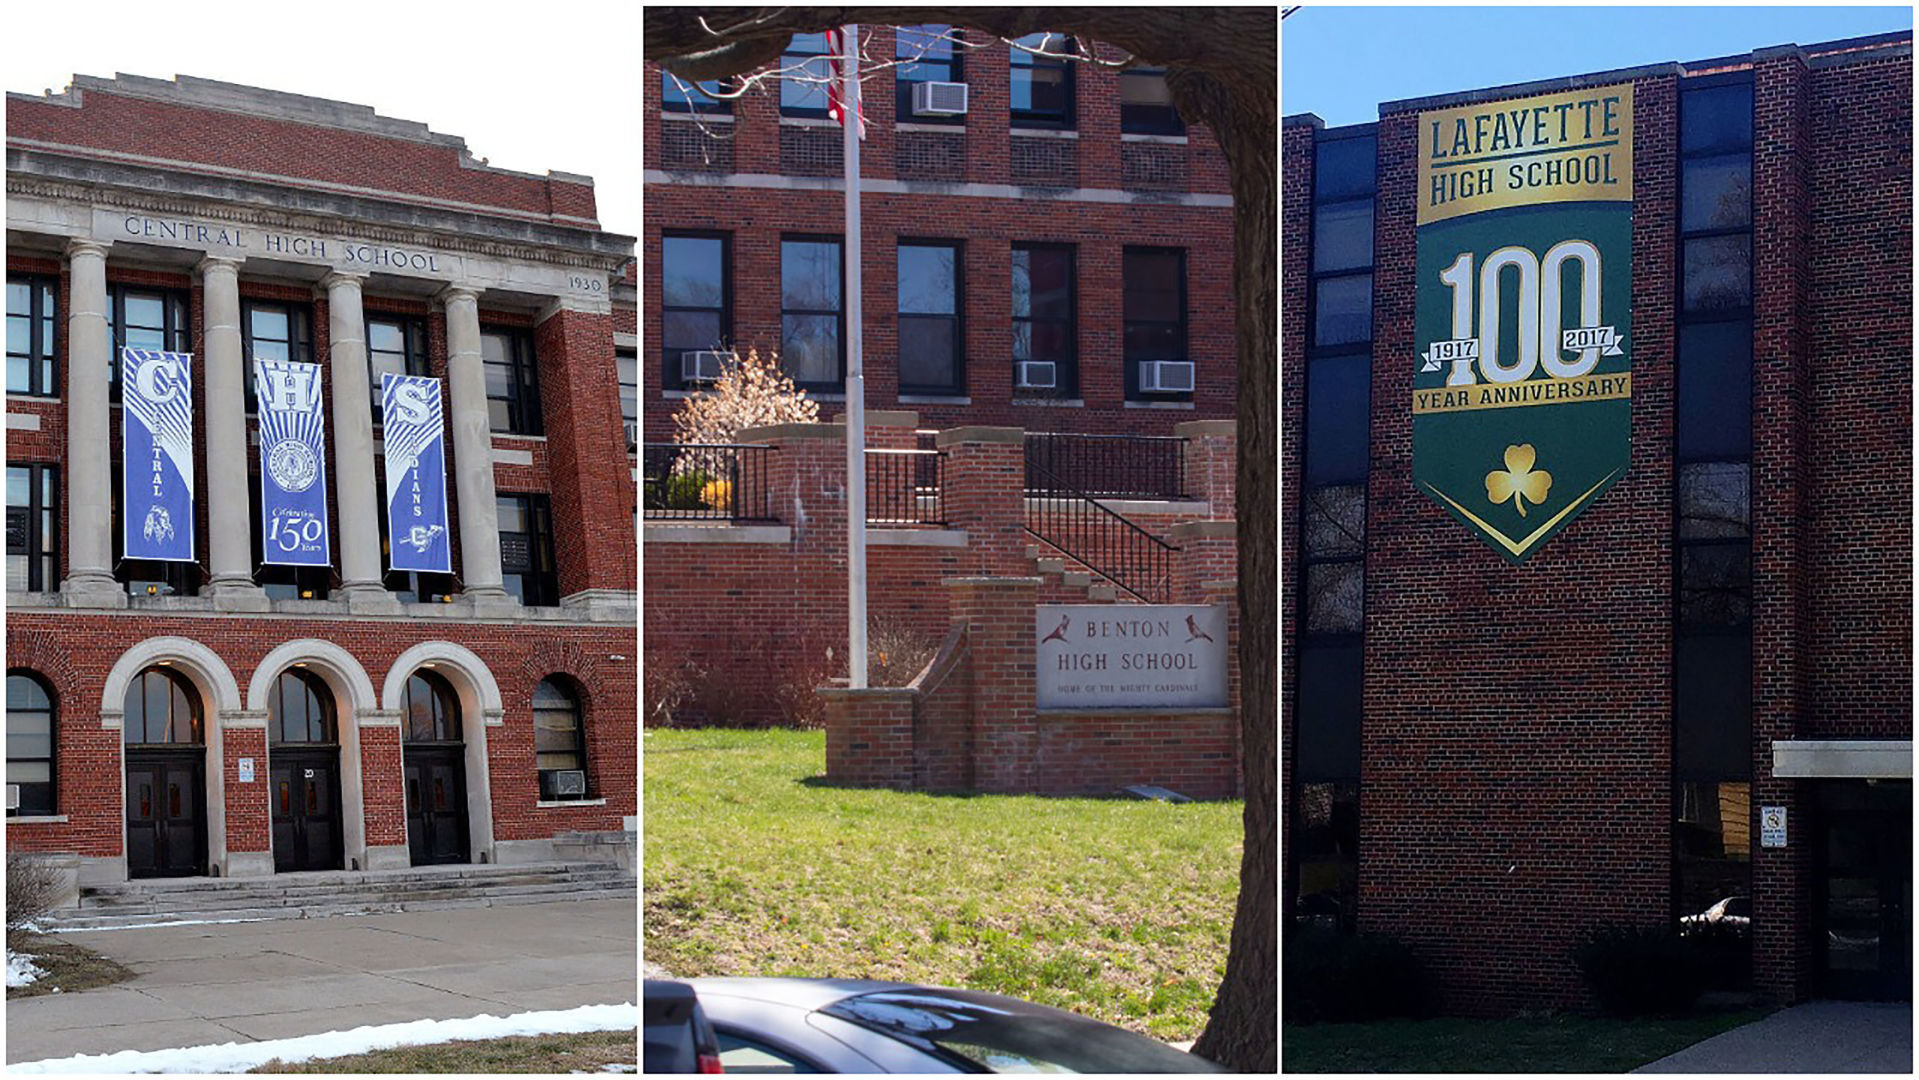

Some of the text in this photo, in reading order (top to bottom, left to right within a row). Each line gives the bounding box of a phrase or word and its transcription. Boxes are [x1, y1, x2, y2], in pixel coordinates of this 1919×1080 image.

[1431, 96, 1620, 159] LAFAYETTE
[1430, 153, 1618, 206] HIGH SCHOOL
[124, 216, 441, 273] CENTRAL HIGH SCHOOL
[569, 276, 602, 291] 1930
[1439, 239, 1602, 388] 100
[1434, 341, 1475, 359] 1917
[1565, 328, 1609, 348] 2017
[136, 358, 179, 405] C
[1417, 377, 1627, 409] YEAR ANNIVERSARY
[269, 516, 323, 552] 150
[1086, 620, 1170, 638] BENTON
[1057, 653, 1199, 671] HIGH SCHOOL
[1057, 684, 1081, 693] HOME
[1084, 684, 1097, 693] OF
[1100, 684, 1115, 693] THE
